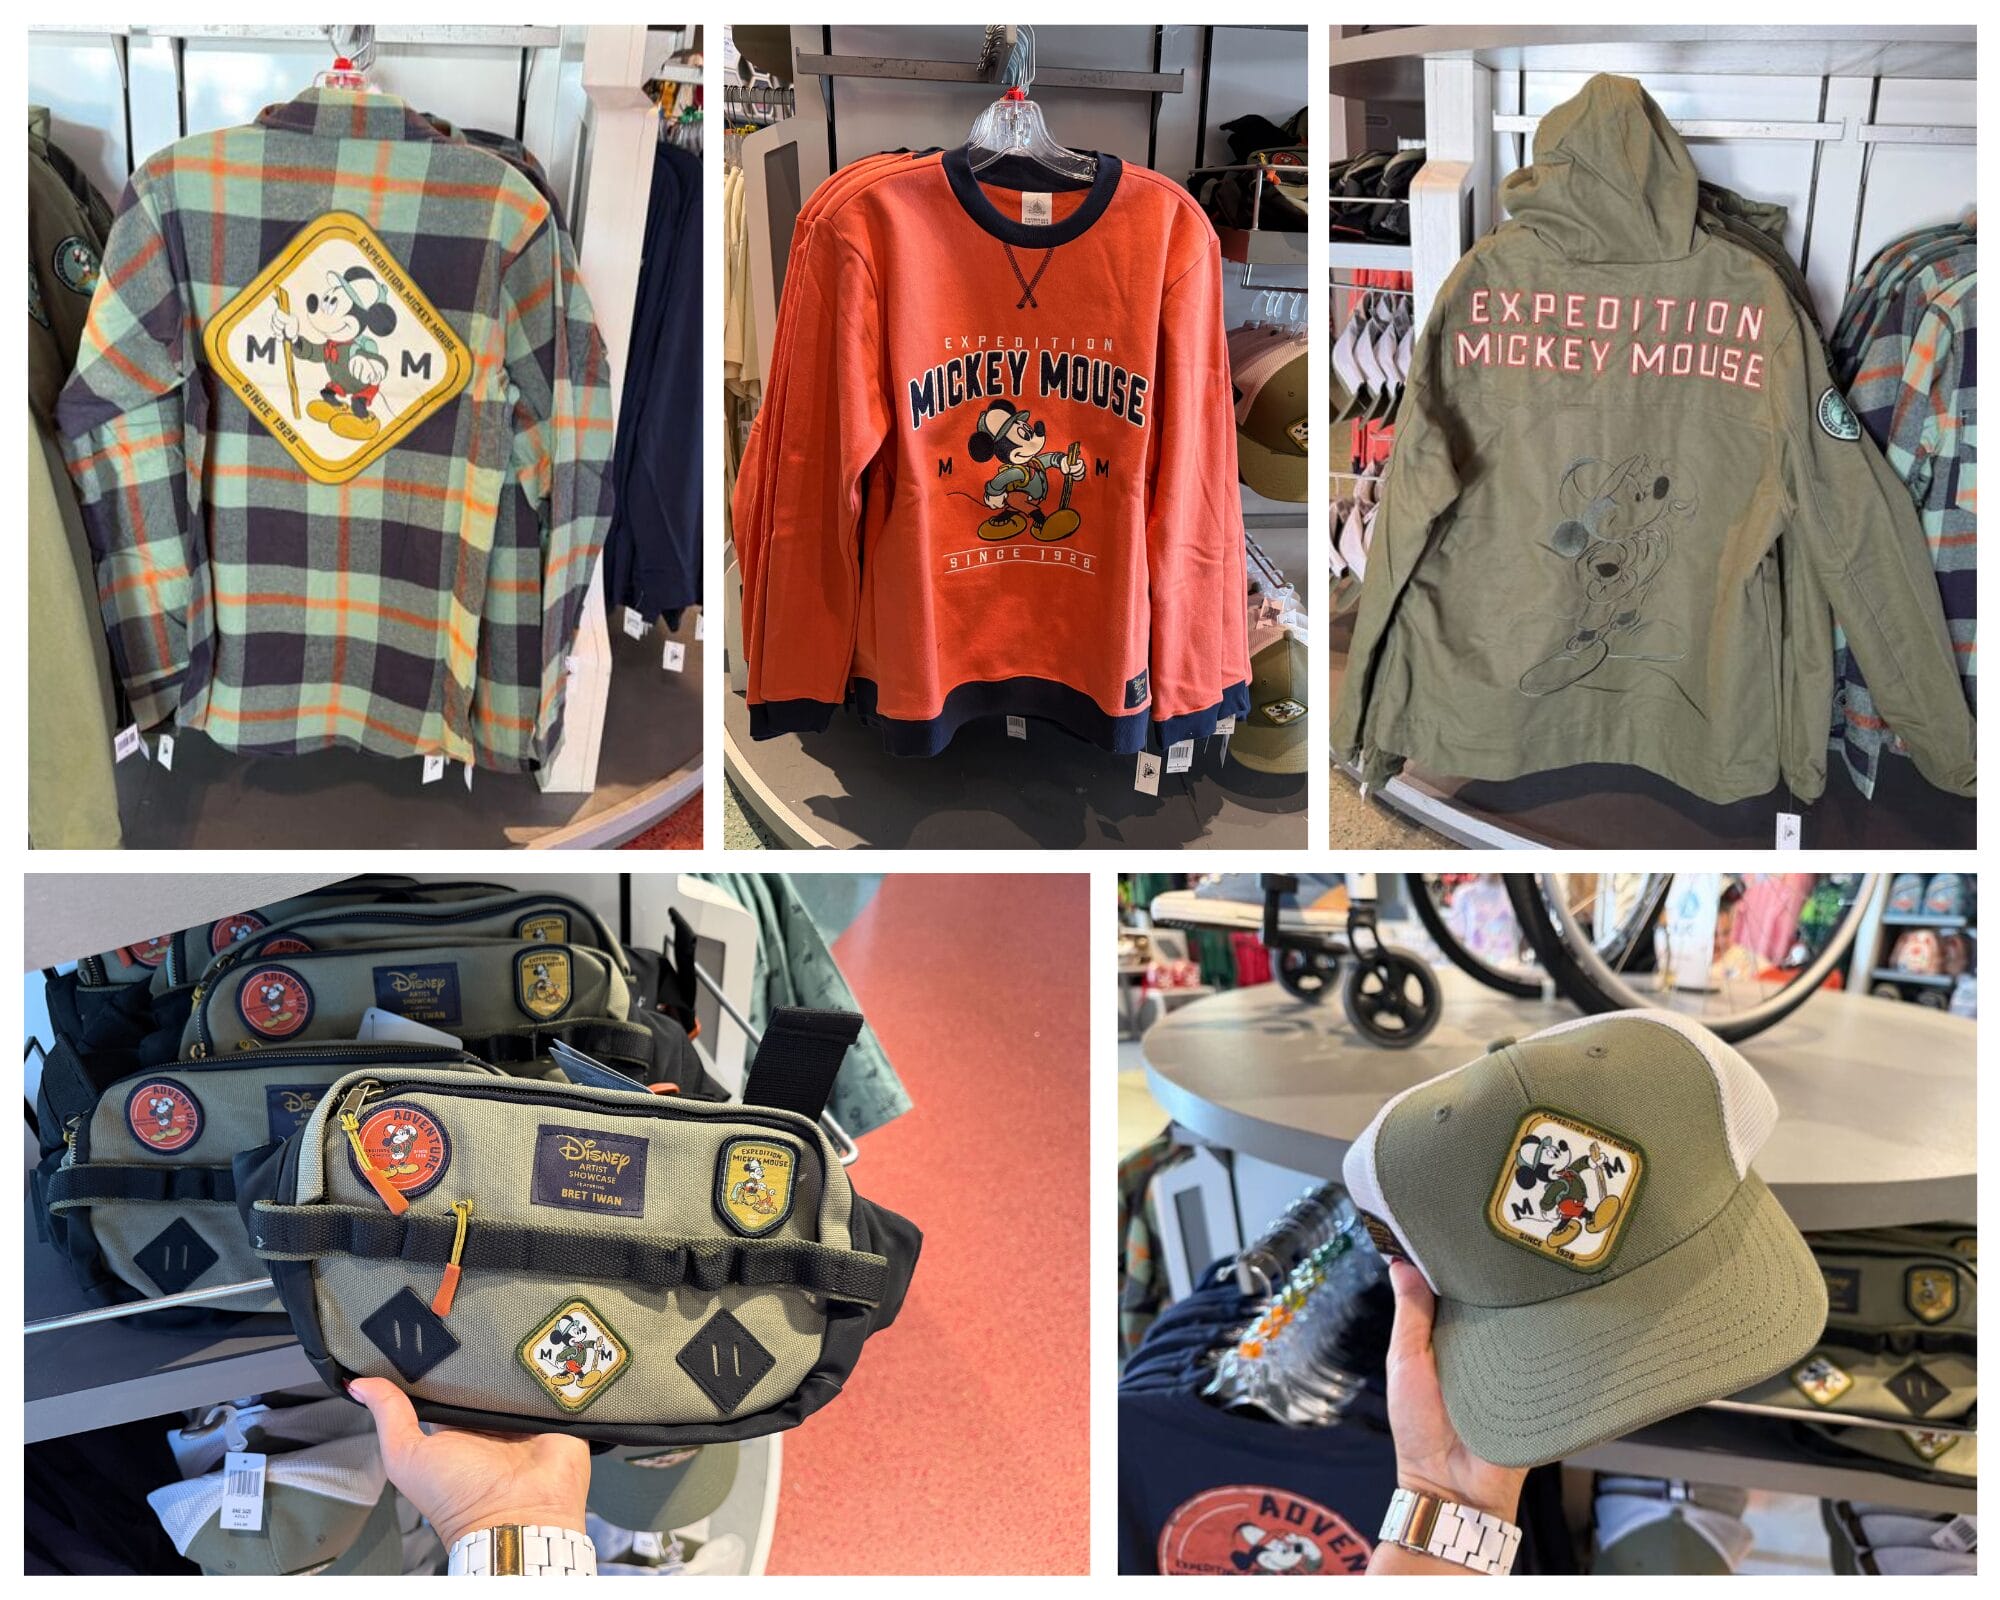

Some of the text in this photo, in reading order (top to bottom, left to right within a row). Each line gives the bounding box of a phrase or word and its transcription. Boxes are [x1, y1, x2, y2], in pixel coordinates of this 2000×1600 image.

[358, 237, 457, 354] EXPEDITION MICKEY MOUSE
[1469, 289, 1765, 341] EXPEDITION
[246, 334, 276, 364] M
[944, 335, 1114, 351] EXPEDITION
[400, 350, 432, 380] M
[1457, 333, 1765, 389] MICKEY MOUSE
[908, 350, 1149, 430] MICKEY MOUSE
[241, 383, 298, 446] SINCE 1928
[938, 456, 953, 478] M
[1095, 458, 1110, 478] M
[949, 548, 1090, 569] SINCE 1928
[263, 973, 306, 1016] ADVENTURE
[153, 1086, 195, 1132] ADVENTURE
[1542, 1113, 1586, 1134] EXPEDITION
[393, 1110, 441, 1172] ADVENTURE
[556, 1134, 630, 1175] Disney
[741, 1148, 783, 1159] EXPEDITION
[762, 1159, 789, 1168] MOUSE
[569, 1171, 617, 1184] SHOWCASE
[579, 1163, 608, 1173] ARTIST
[1604, 1156, 1626, 1178] M
[561, 1188, 622, 1206] BRET IWAN
[1511, 1198, 1534, 1220] M
[1518, 1232, 1575, 1261] SINCE 1928
[540, 1348, 552, 1360] M
[600, 1350, 612, 1361] M
[536, 1366, 549, 1380] SINCE
